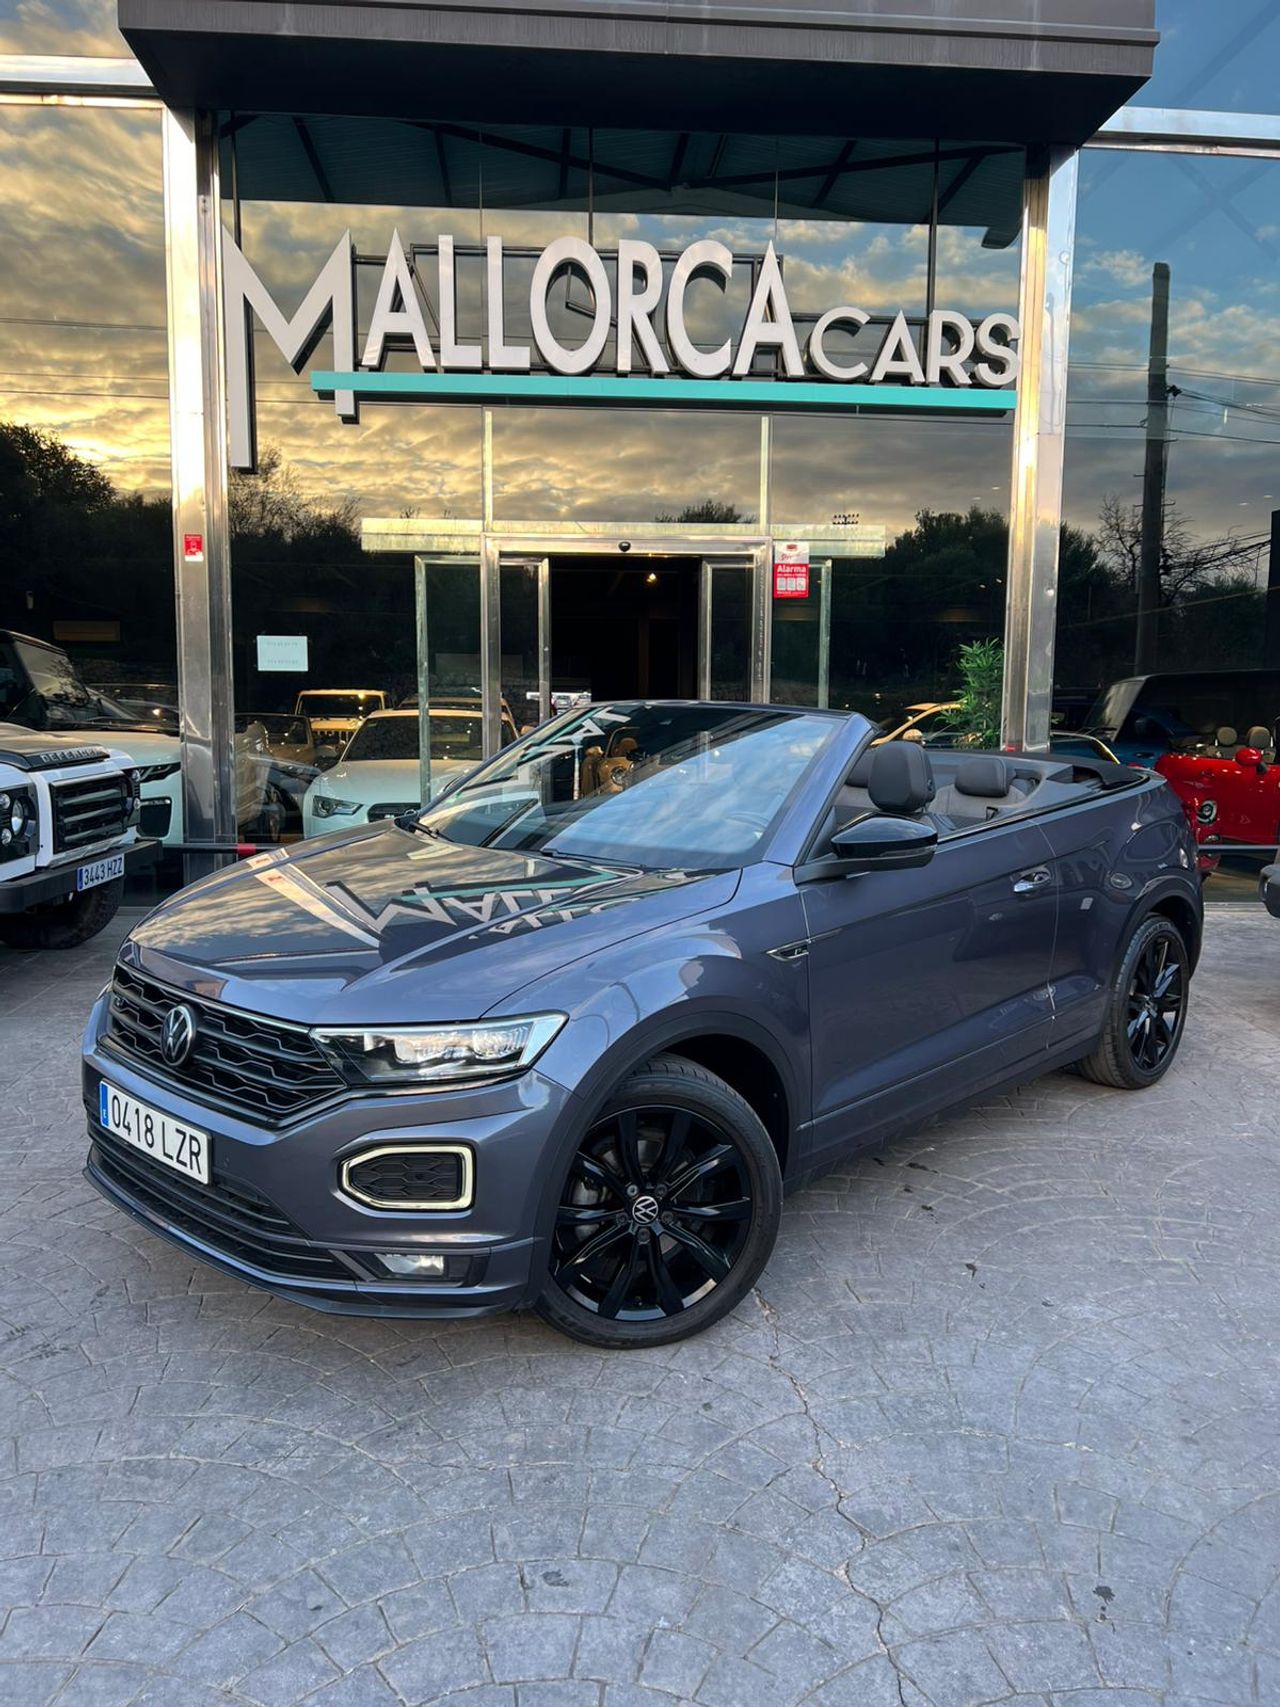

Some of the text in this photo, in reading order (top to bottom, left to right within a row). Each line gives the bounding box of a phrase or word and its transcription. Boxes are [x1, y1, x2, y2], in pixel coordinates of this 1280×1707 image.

[221, 223, 1020, 469] MALLORCA CARS
[777, 564, 807, 574] Alarma
[84, 856, 123, 886] 3443 HZZ
[111, 1094, 202, 1175] 0418 LZR
